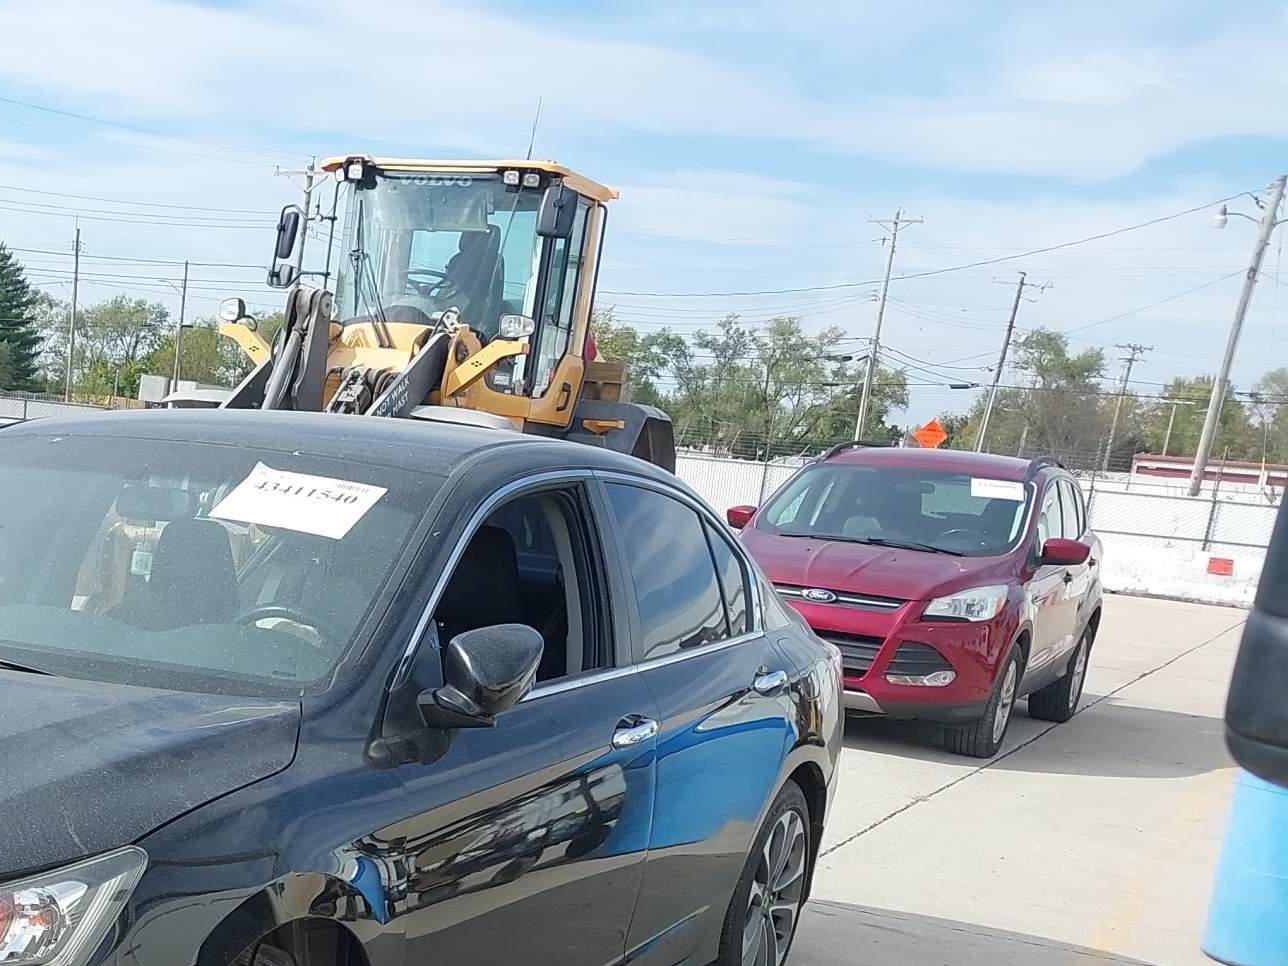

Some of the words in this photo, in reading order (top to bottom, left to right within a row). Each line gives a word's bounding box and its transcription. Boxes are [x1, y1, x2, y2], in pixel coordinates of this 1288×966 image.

[399, 175, 473, 187] VOLVO
[376, 396, 390, 417] NOT
[391, 375, 410, 401] WALK
[392, 391, 409, 416] MAST
